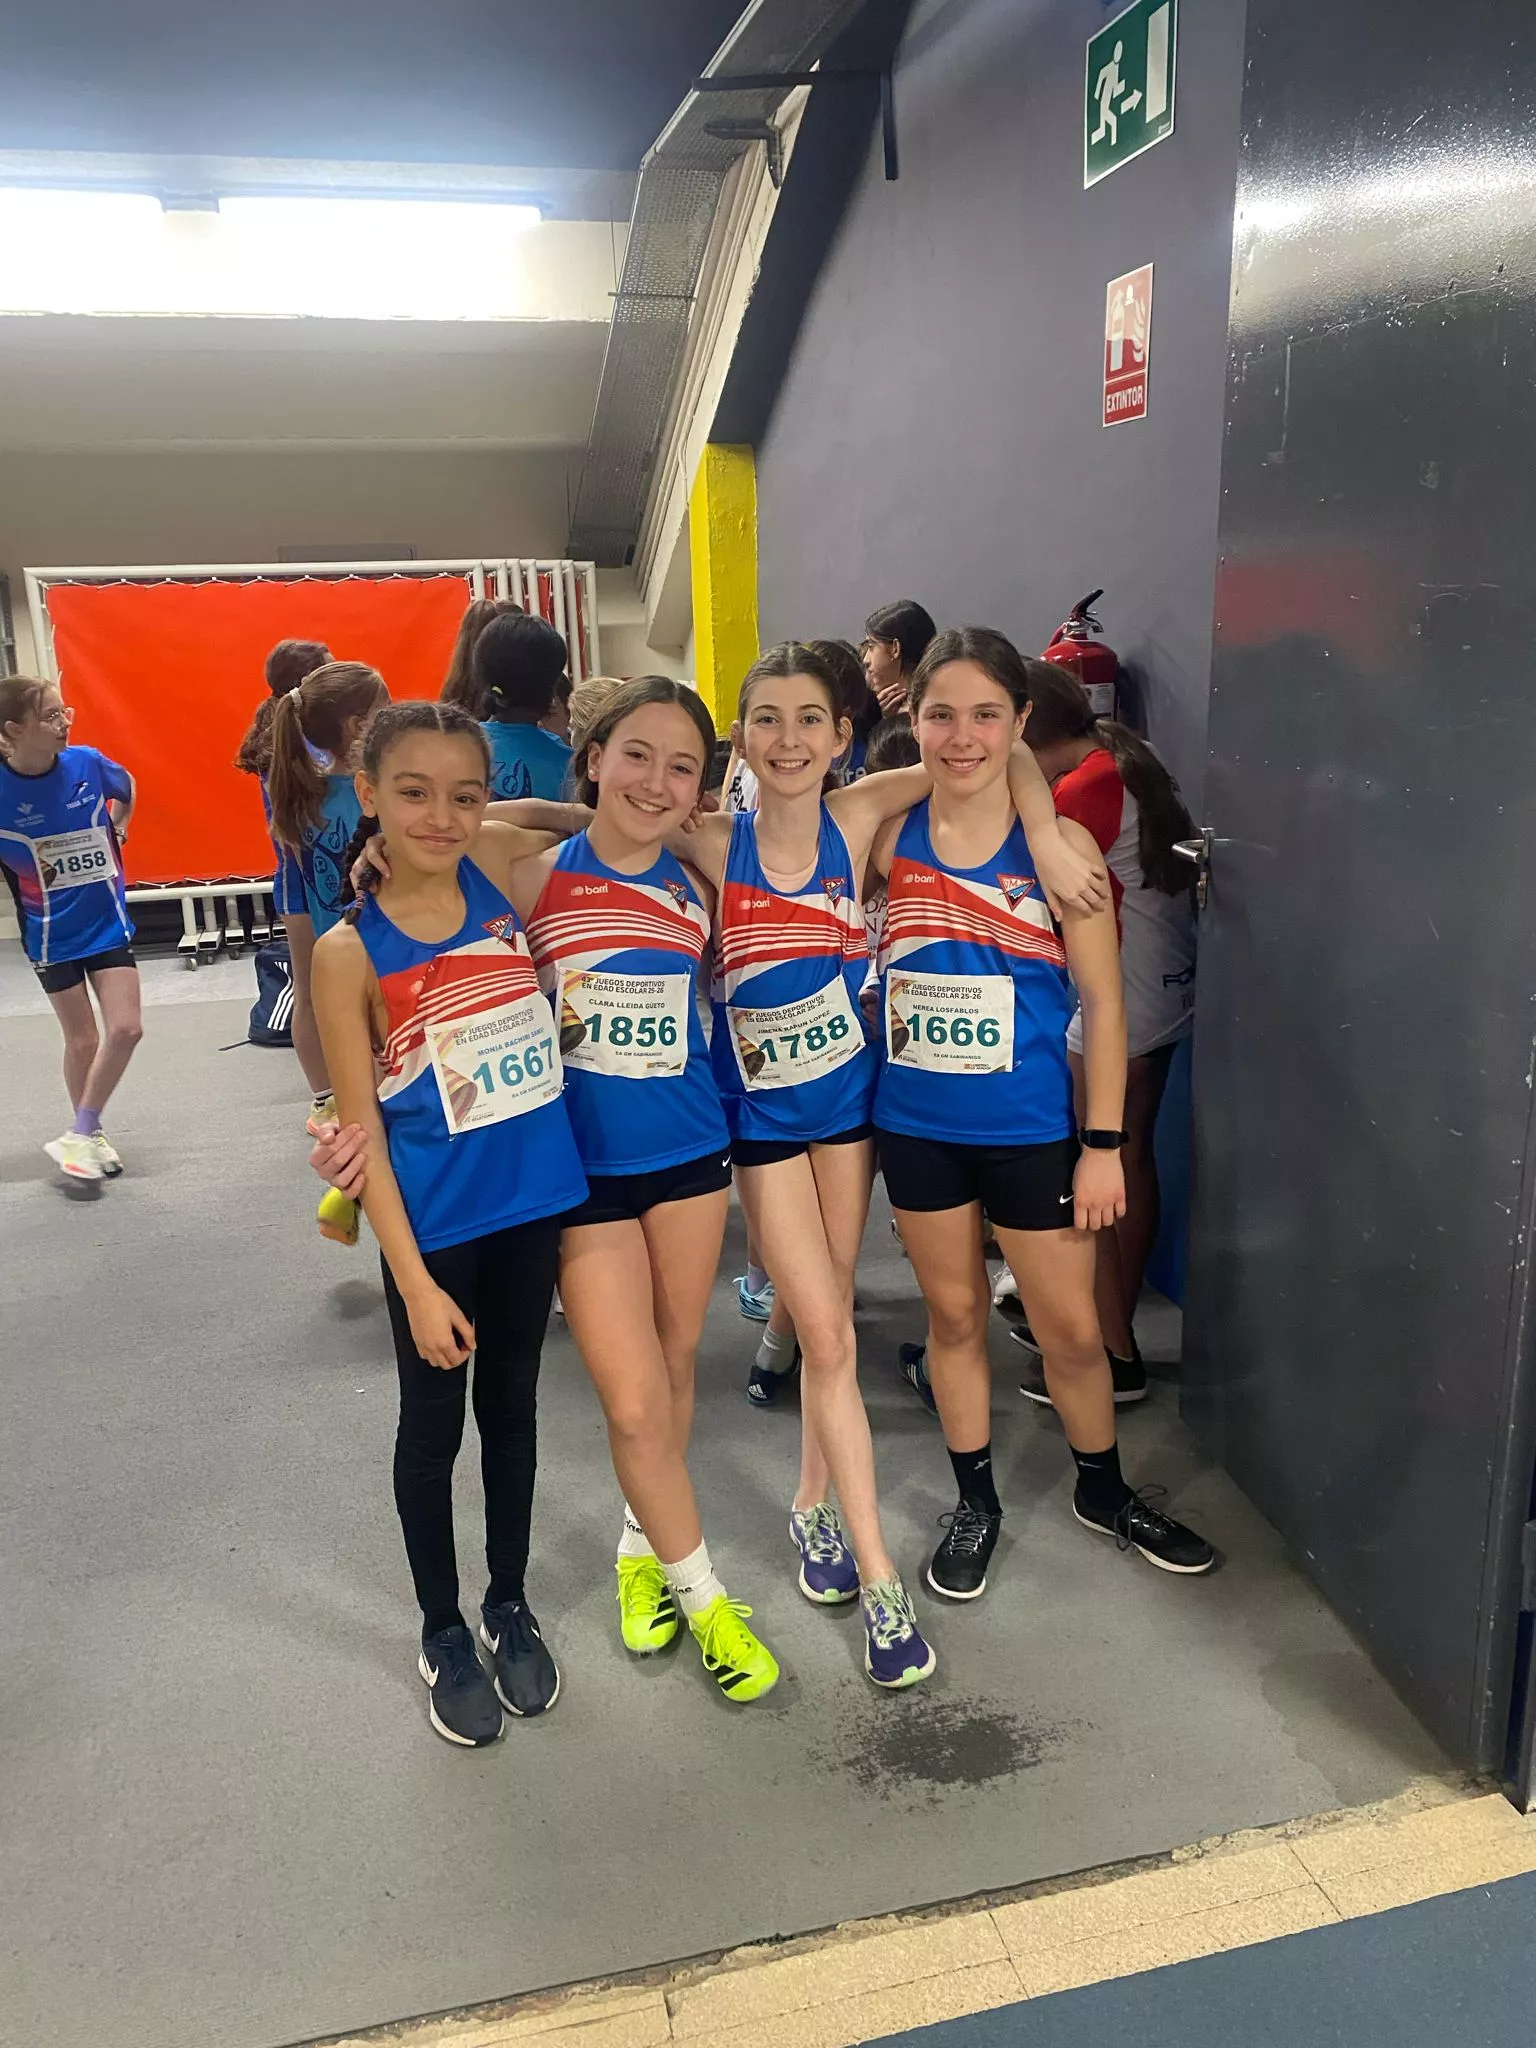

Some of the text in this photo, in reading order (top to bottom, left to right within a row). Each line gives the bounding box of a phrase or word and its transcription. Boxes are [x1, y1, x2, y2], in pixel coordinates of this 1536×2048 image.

[1106, 384, 1143, 413] EXTINTOR
[53, 850, 107, 874] 1858
[914, 872, 936, 884] barri
[584, 882, 608, 895] barri
[593, 984, 614, 992] EDAD
[615, 986, 647, 994] ESCOLAR
[595, 977, 625, 987] JUEGOS
[626, 980, 665, 988] DEPORTIVOS
[911, 983, 935, 991] JUEGOS
[937, 985, 982, 993] DEPORTIVOS
[911, 989, 928, 997] EDAD
[929, 991, 959, 999] ESCOLAR
[588, 998, 615, 1008] CLARA
[782, 993, 825, 1015] DEPORTIVOS
[912, 1004, 934, 1012] NEREA
[468, 1020, 497, 1035] JUEGOS
[497, 1007, 534, 1027] DEPORTIVOS
[775, 1008, 806, 1022] ESCOLAR
[455, 1037, 467, 1046] EN
[468, 1030, 490, 1043] EDAD
[491, 1020, 520, 1036] ESCOLAR
[584, 1013, 677, 1047] 1856
[906, 1013, 1001, 1047] 1666
[758, 1014, 849, 1063] 1788
[477, 1044, 503, 1057] MONIA
[472, 1036, 553, 1094] 1667
